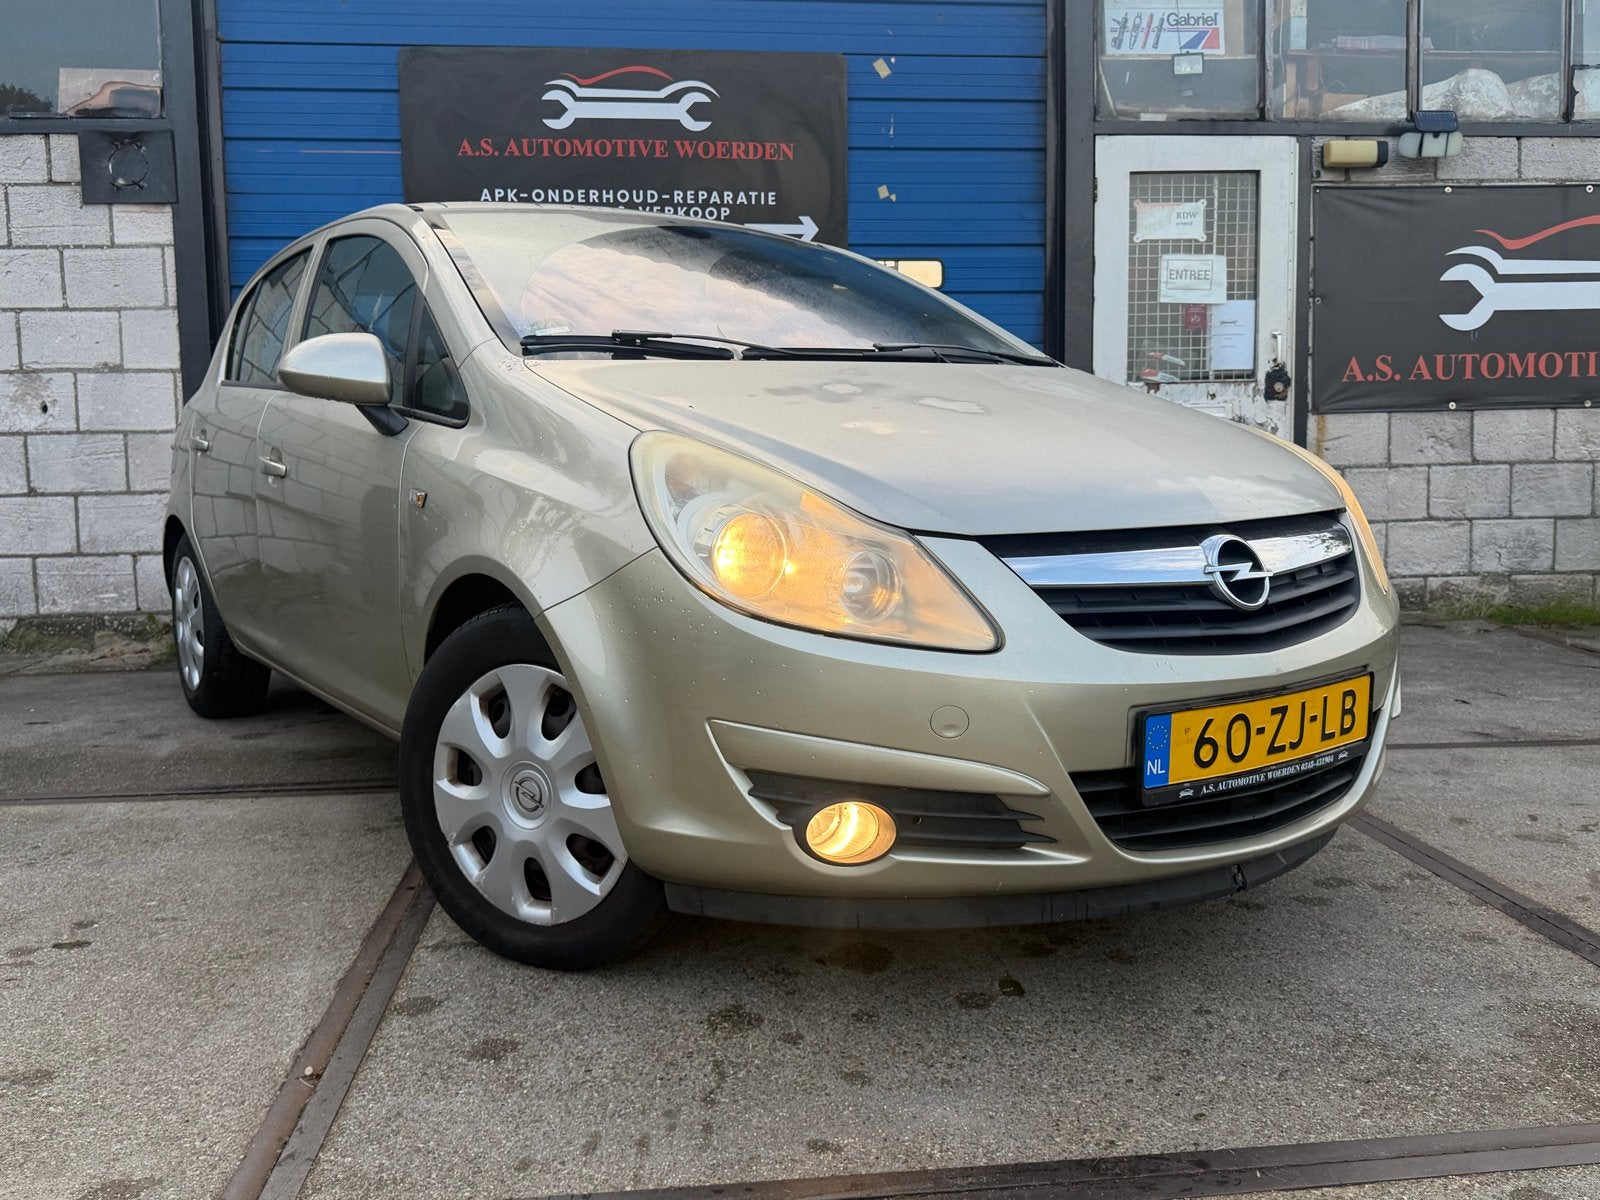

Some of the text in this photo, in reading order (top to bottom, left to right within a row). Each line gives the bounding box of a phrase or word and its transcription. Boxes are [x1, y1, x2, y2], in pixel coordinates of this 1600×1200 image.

[1166, 12, 1218, 27] Gabriel
[457, 137, 795, 161] A.S. AUTOMOTIVE WOERDEN
[480, 188, 777, 206] APK-ONDERHOUD-REPARATIE
[1176, 211, 1198, 219] RDW
[1168, 268, 1211, 281] ENTREE
[1341, 351, 1600, 383] A.S. AUTOMOTI
[1193, 688, 1357, 769] 60-ZJ-LB
[1146, 759, 1166, 776] NL
[1200, 783, 1216, 796] A.S.
[1217, 772, 1266, 792] AUTOMOTIVE
[1267, 764, 1300, 781] WOERDEN
